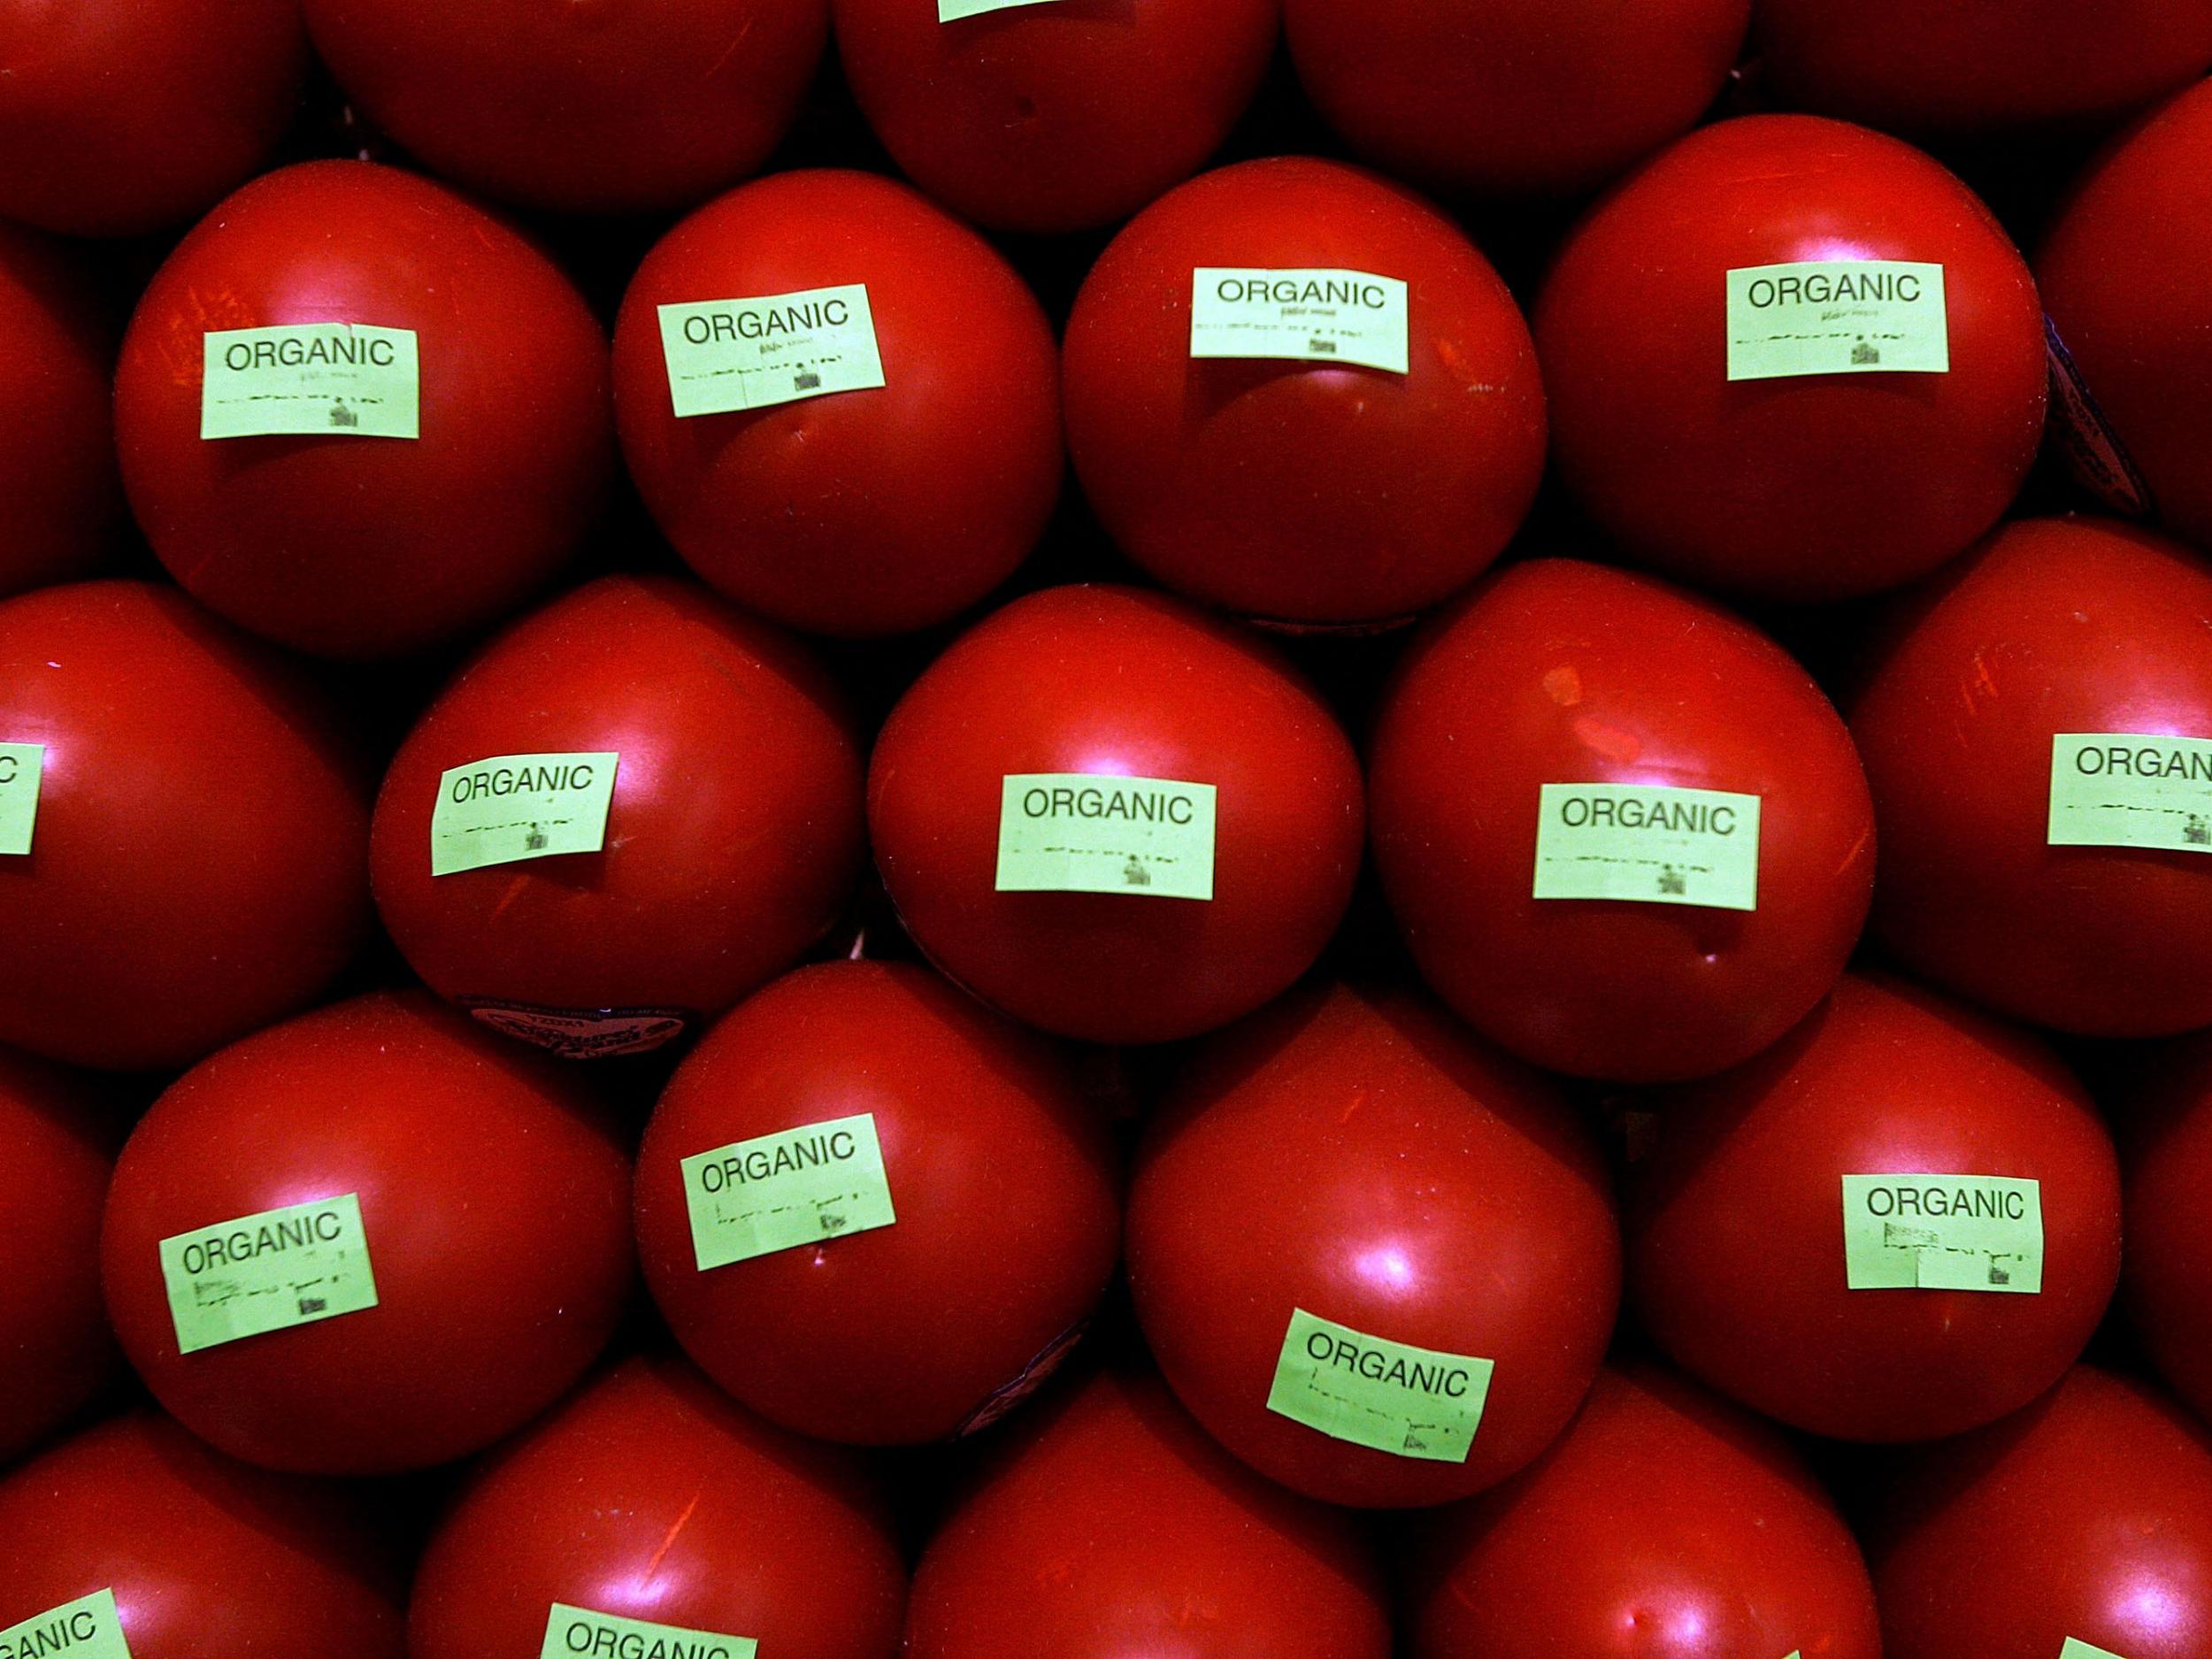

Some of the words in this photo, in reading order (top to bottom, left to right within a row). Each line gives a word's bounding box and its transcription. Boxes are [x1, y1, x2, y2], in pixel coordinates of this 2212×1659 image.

[1217, 278, 1386, 310] ORGANIC
[1748, 274, 1919, 309] ORGANIC
[684, 300, 849, 345] ORGANIC
[226, 337, 394, 372] ORGANIC
[2076, 747, 2212, 780] ORGAN
[453, 764, 594, 804] ORGANIC
[1024, 788, 1193, 824] ORGANIC
[1562, 798, 1736, 835] ORGANIC
[702, 1133, 856, 1195] ORGANIC
[1867, 1187, 2026, 1221] ORGANIC
[183, 1212, 345, 1276] ORGANIC
[1307, 1332, 1471, 1398] ORGANIC
